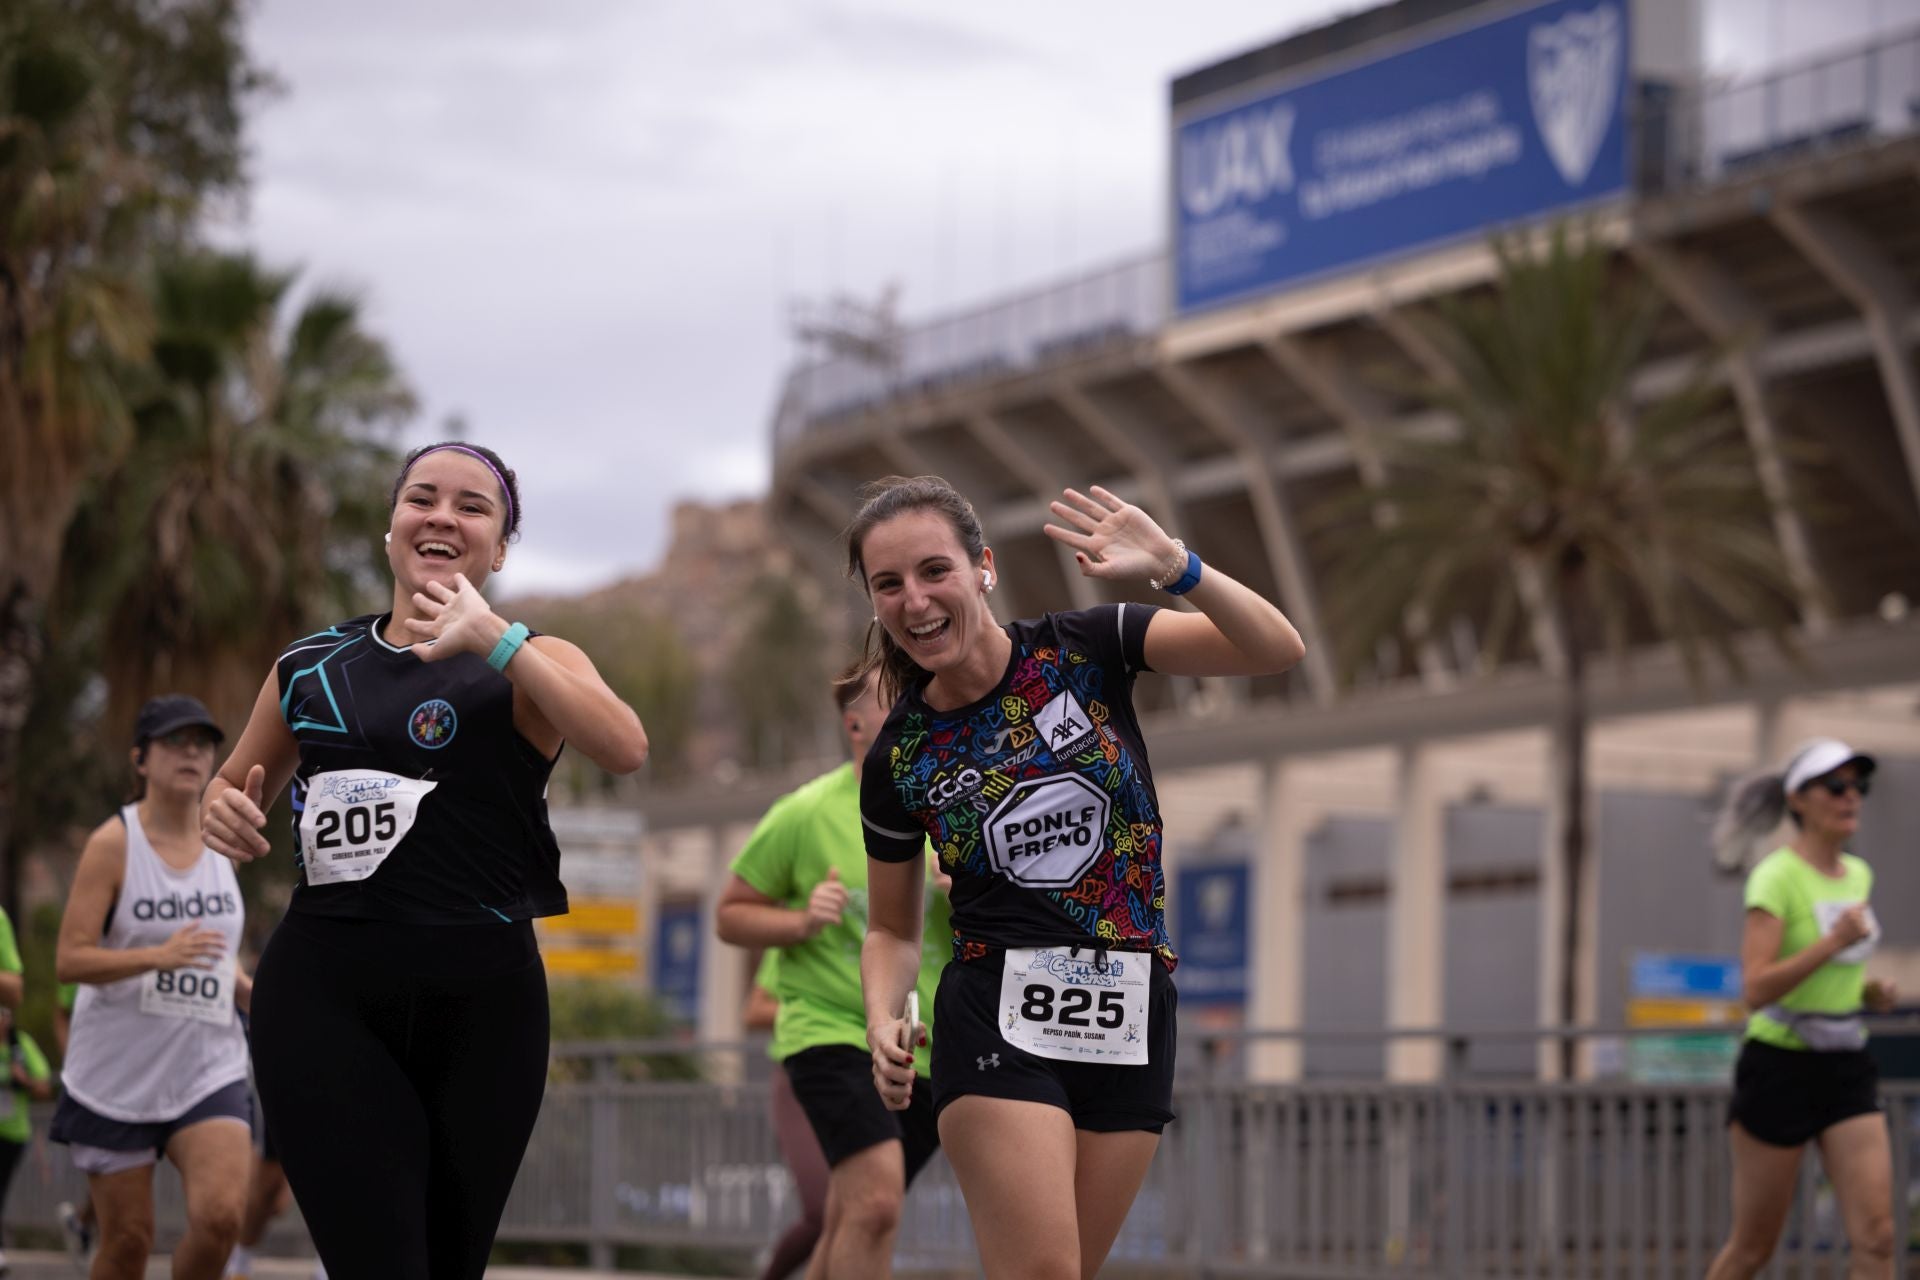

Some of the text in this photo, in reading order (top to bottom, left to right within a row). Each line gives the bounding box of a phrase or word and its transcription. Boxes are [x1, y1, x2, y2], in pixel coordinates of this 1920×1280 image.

[1051, 717, 1084, 750] AXA
[1056, 733, 1099, 762] fundación
[316, 802, 396, 849] 205
[1004, 806, 1096, 843] PONLE
[1008, 826, 1091, 862] FRENO
[134, 891, 236, 921] adidas
[156, 970, 219, 999] 800
[1064, 973, 1115, 987] Prensa
[1020, 984, 1124, 1029] 825
[1042, 1027, 1063, 1036] REPISO
[1084, 1032, 1106, 1040] SUSANA
